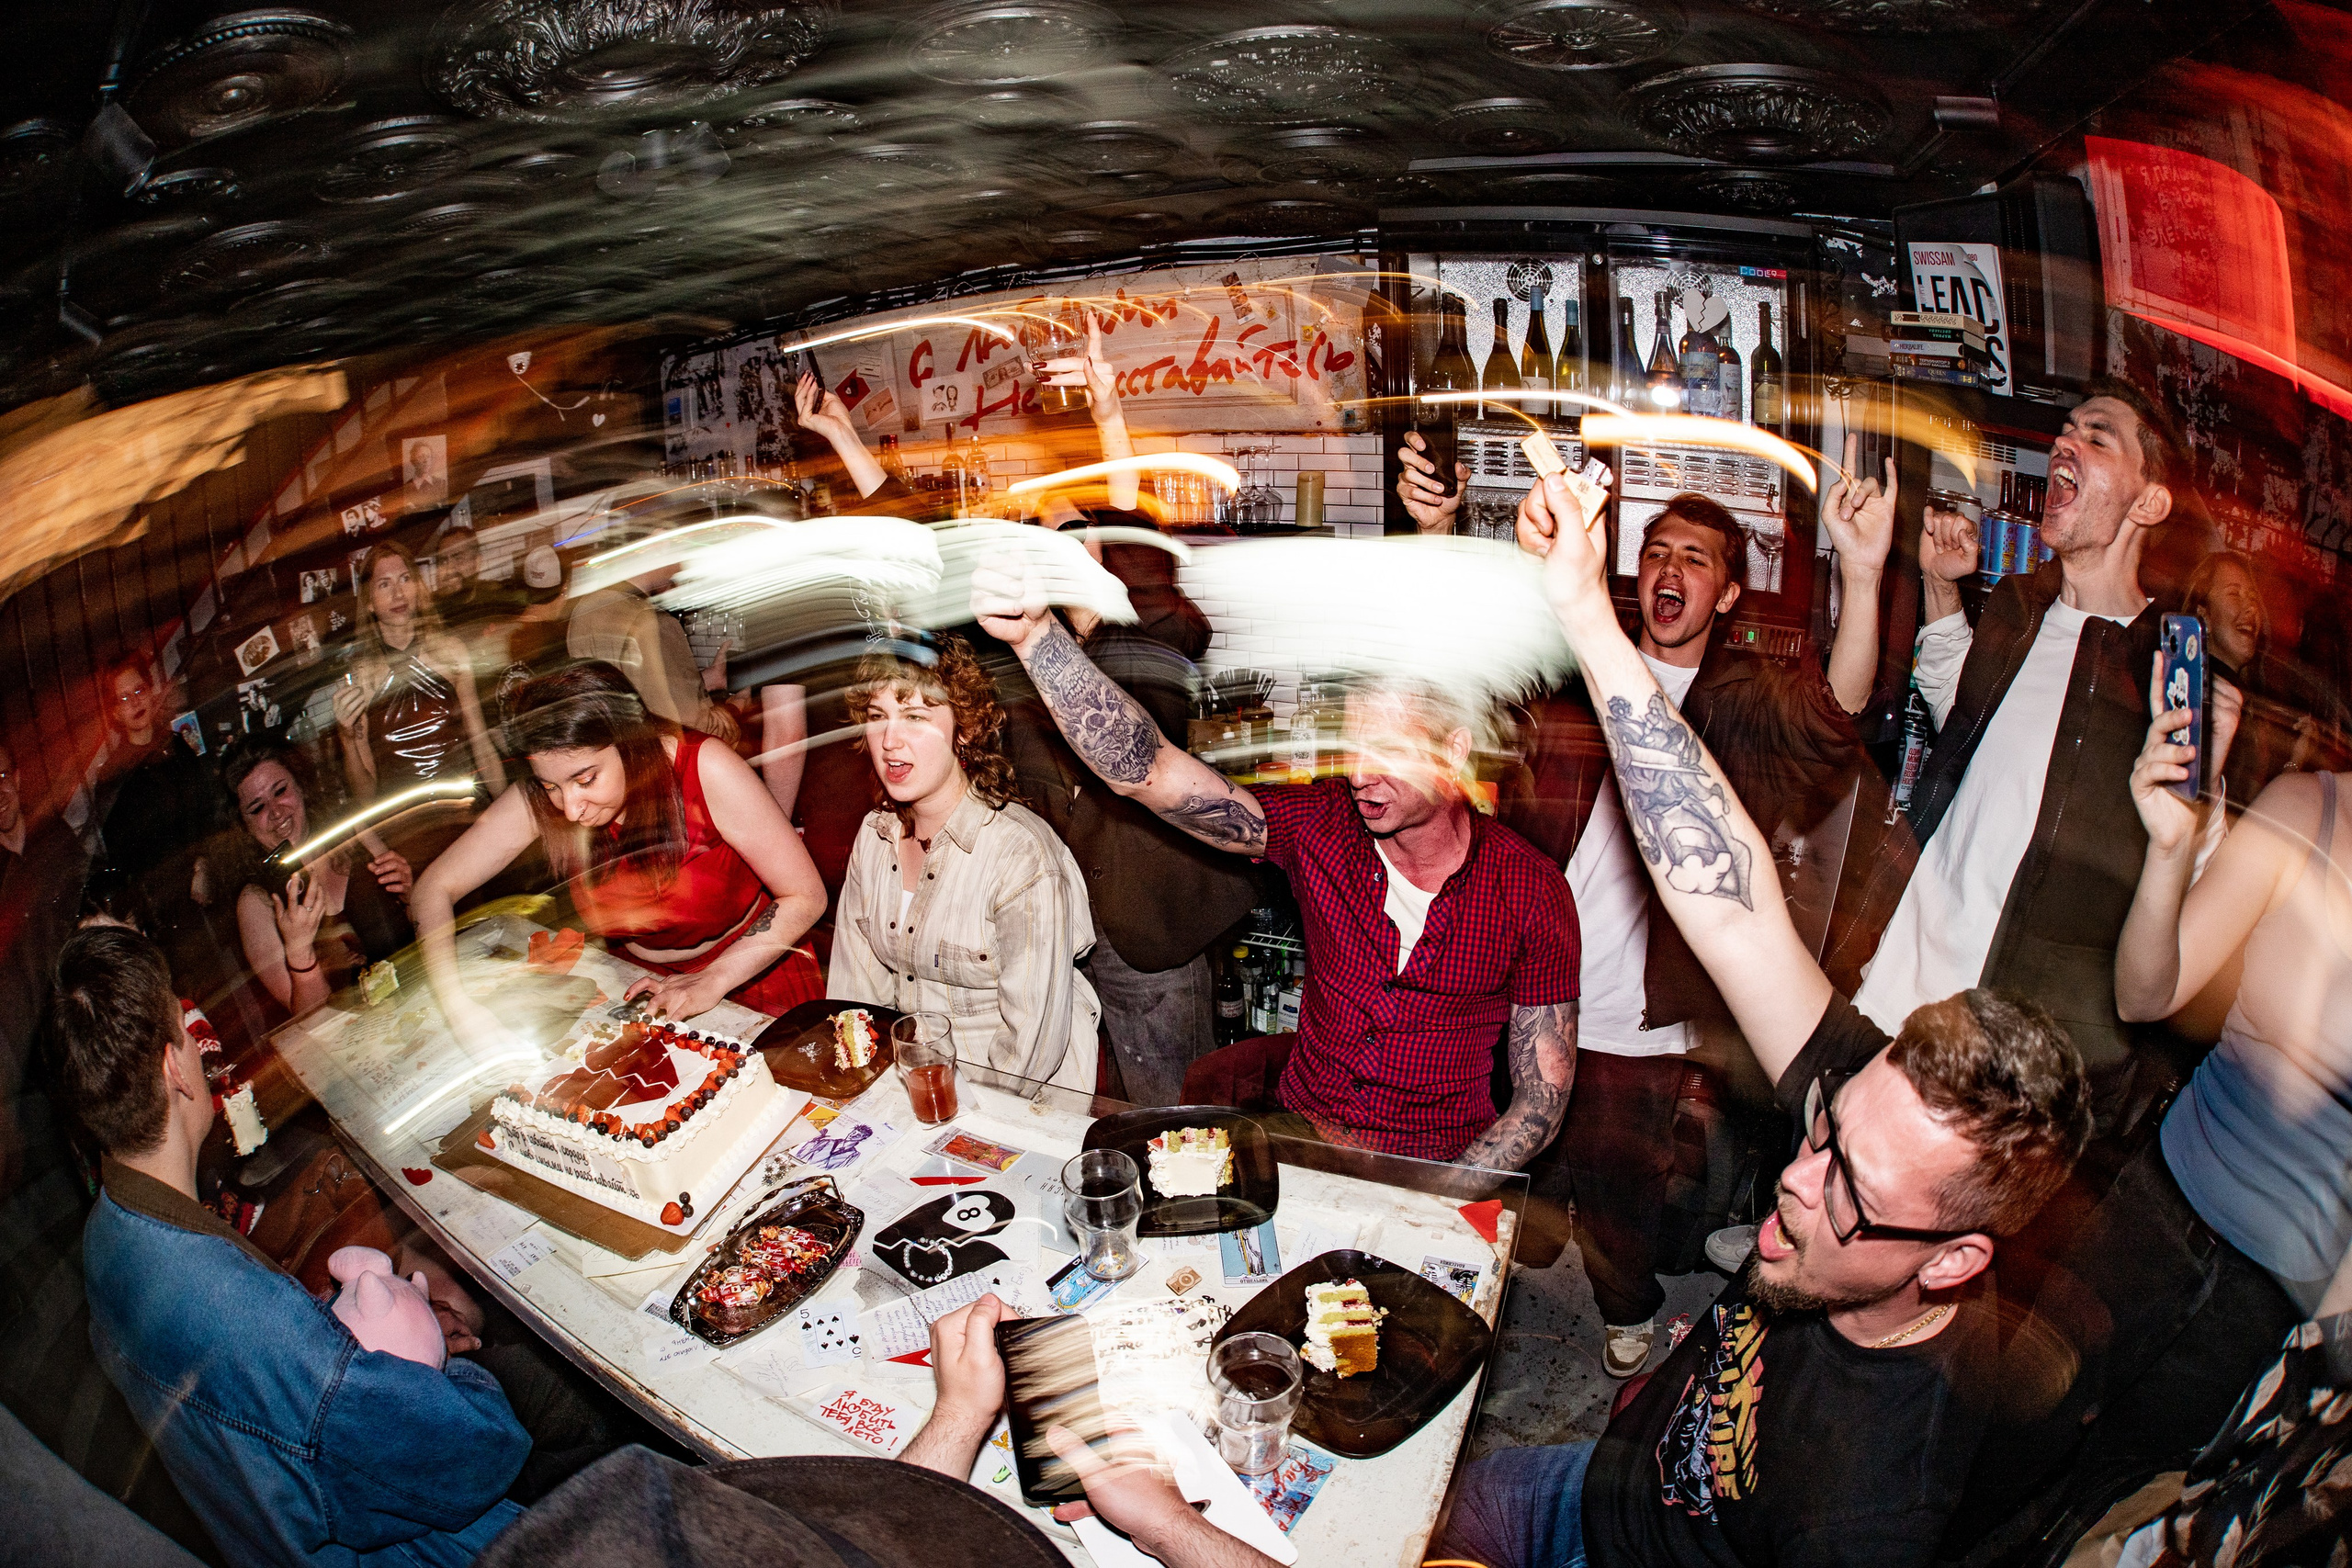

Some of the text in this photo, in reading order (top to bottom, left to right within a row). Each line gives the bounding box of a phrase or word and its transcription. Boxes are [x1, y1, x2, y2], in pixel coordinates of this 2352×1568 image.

[1740, 266, 1777, 277] COOLEQ
[909, 339, 933, 389] С
[1928, 367, 1947, 376] QUEEN
[957, 1206, 980, 1222] 8
[800, 1308, 809, 1319] 5
[841, 1390, 896, 1416] Я БУДУ
[820, 1404, 853, 1426] ТЕБЯ
